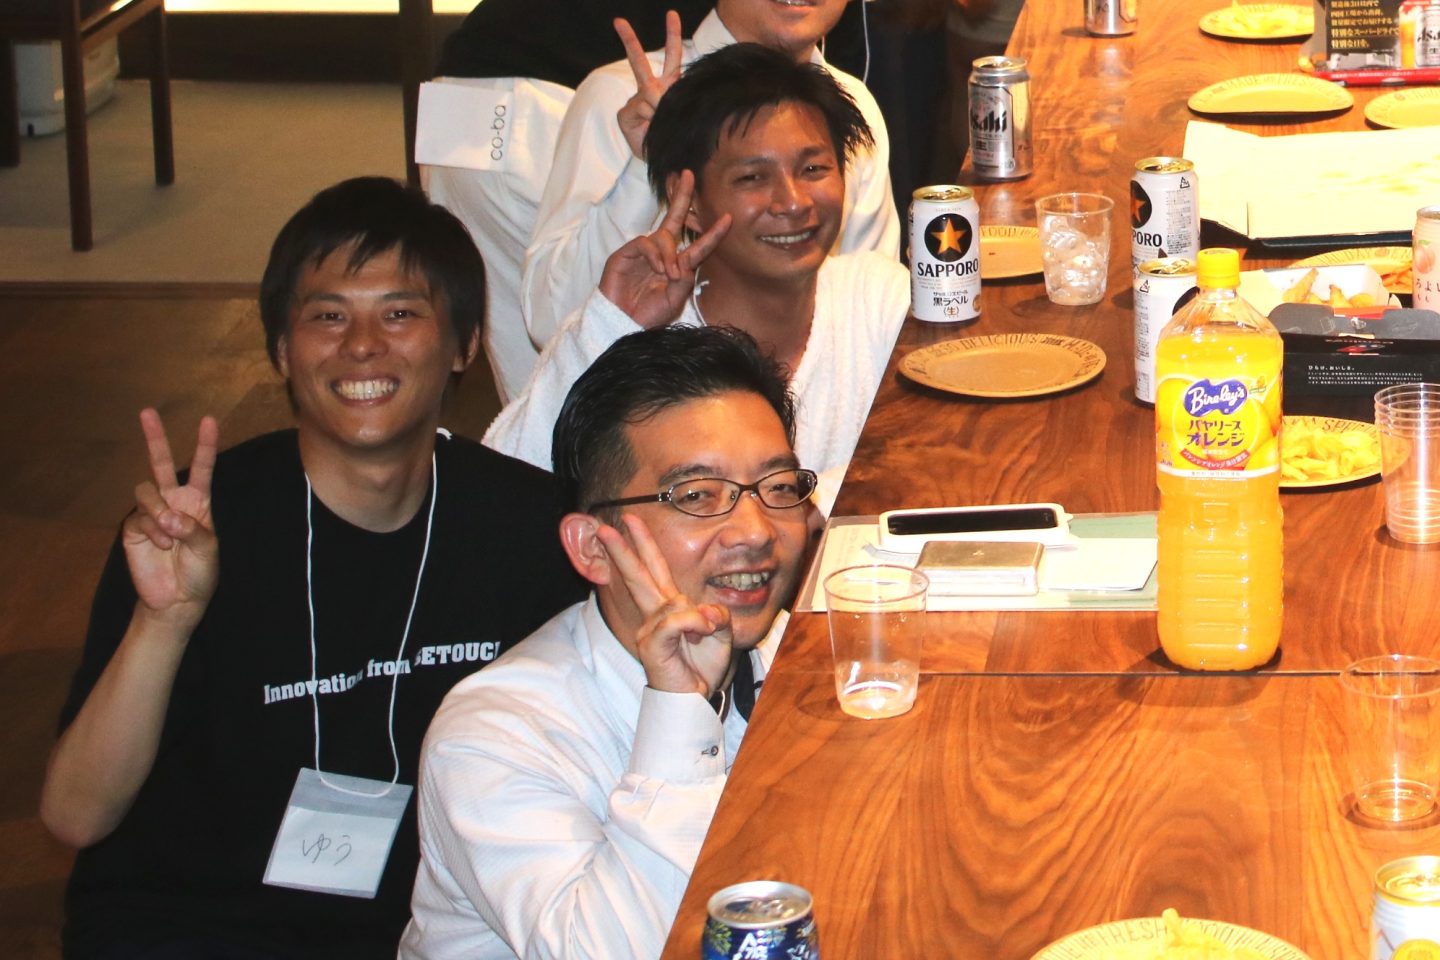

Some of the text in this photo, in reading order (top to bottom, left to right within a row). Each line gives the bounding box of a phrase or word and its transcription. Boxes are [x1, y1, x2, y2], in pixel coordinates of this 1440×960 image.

[490, 104, 507, 161] co-ba
[917, 257, 979, 277] SAPPORO
[933, 296, 969, 307] 黒ラベル
[1187, 384, 1246, 414] Bireley's
[1189, 419, 1242, 432] バヤリース
[1186, 432, 1246, 447] オレンジ
[366, 657, 411, 678] from
